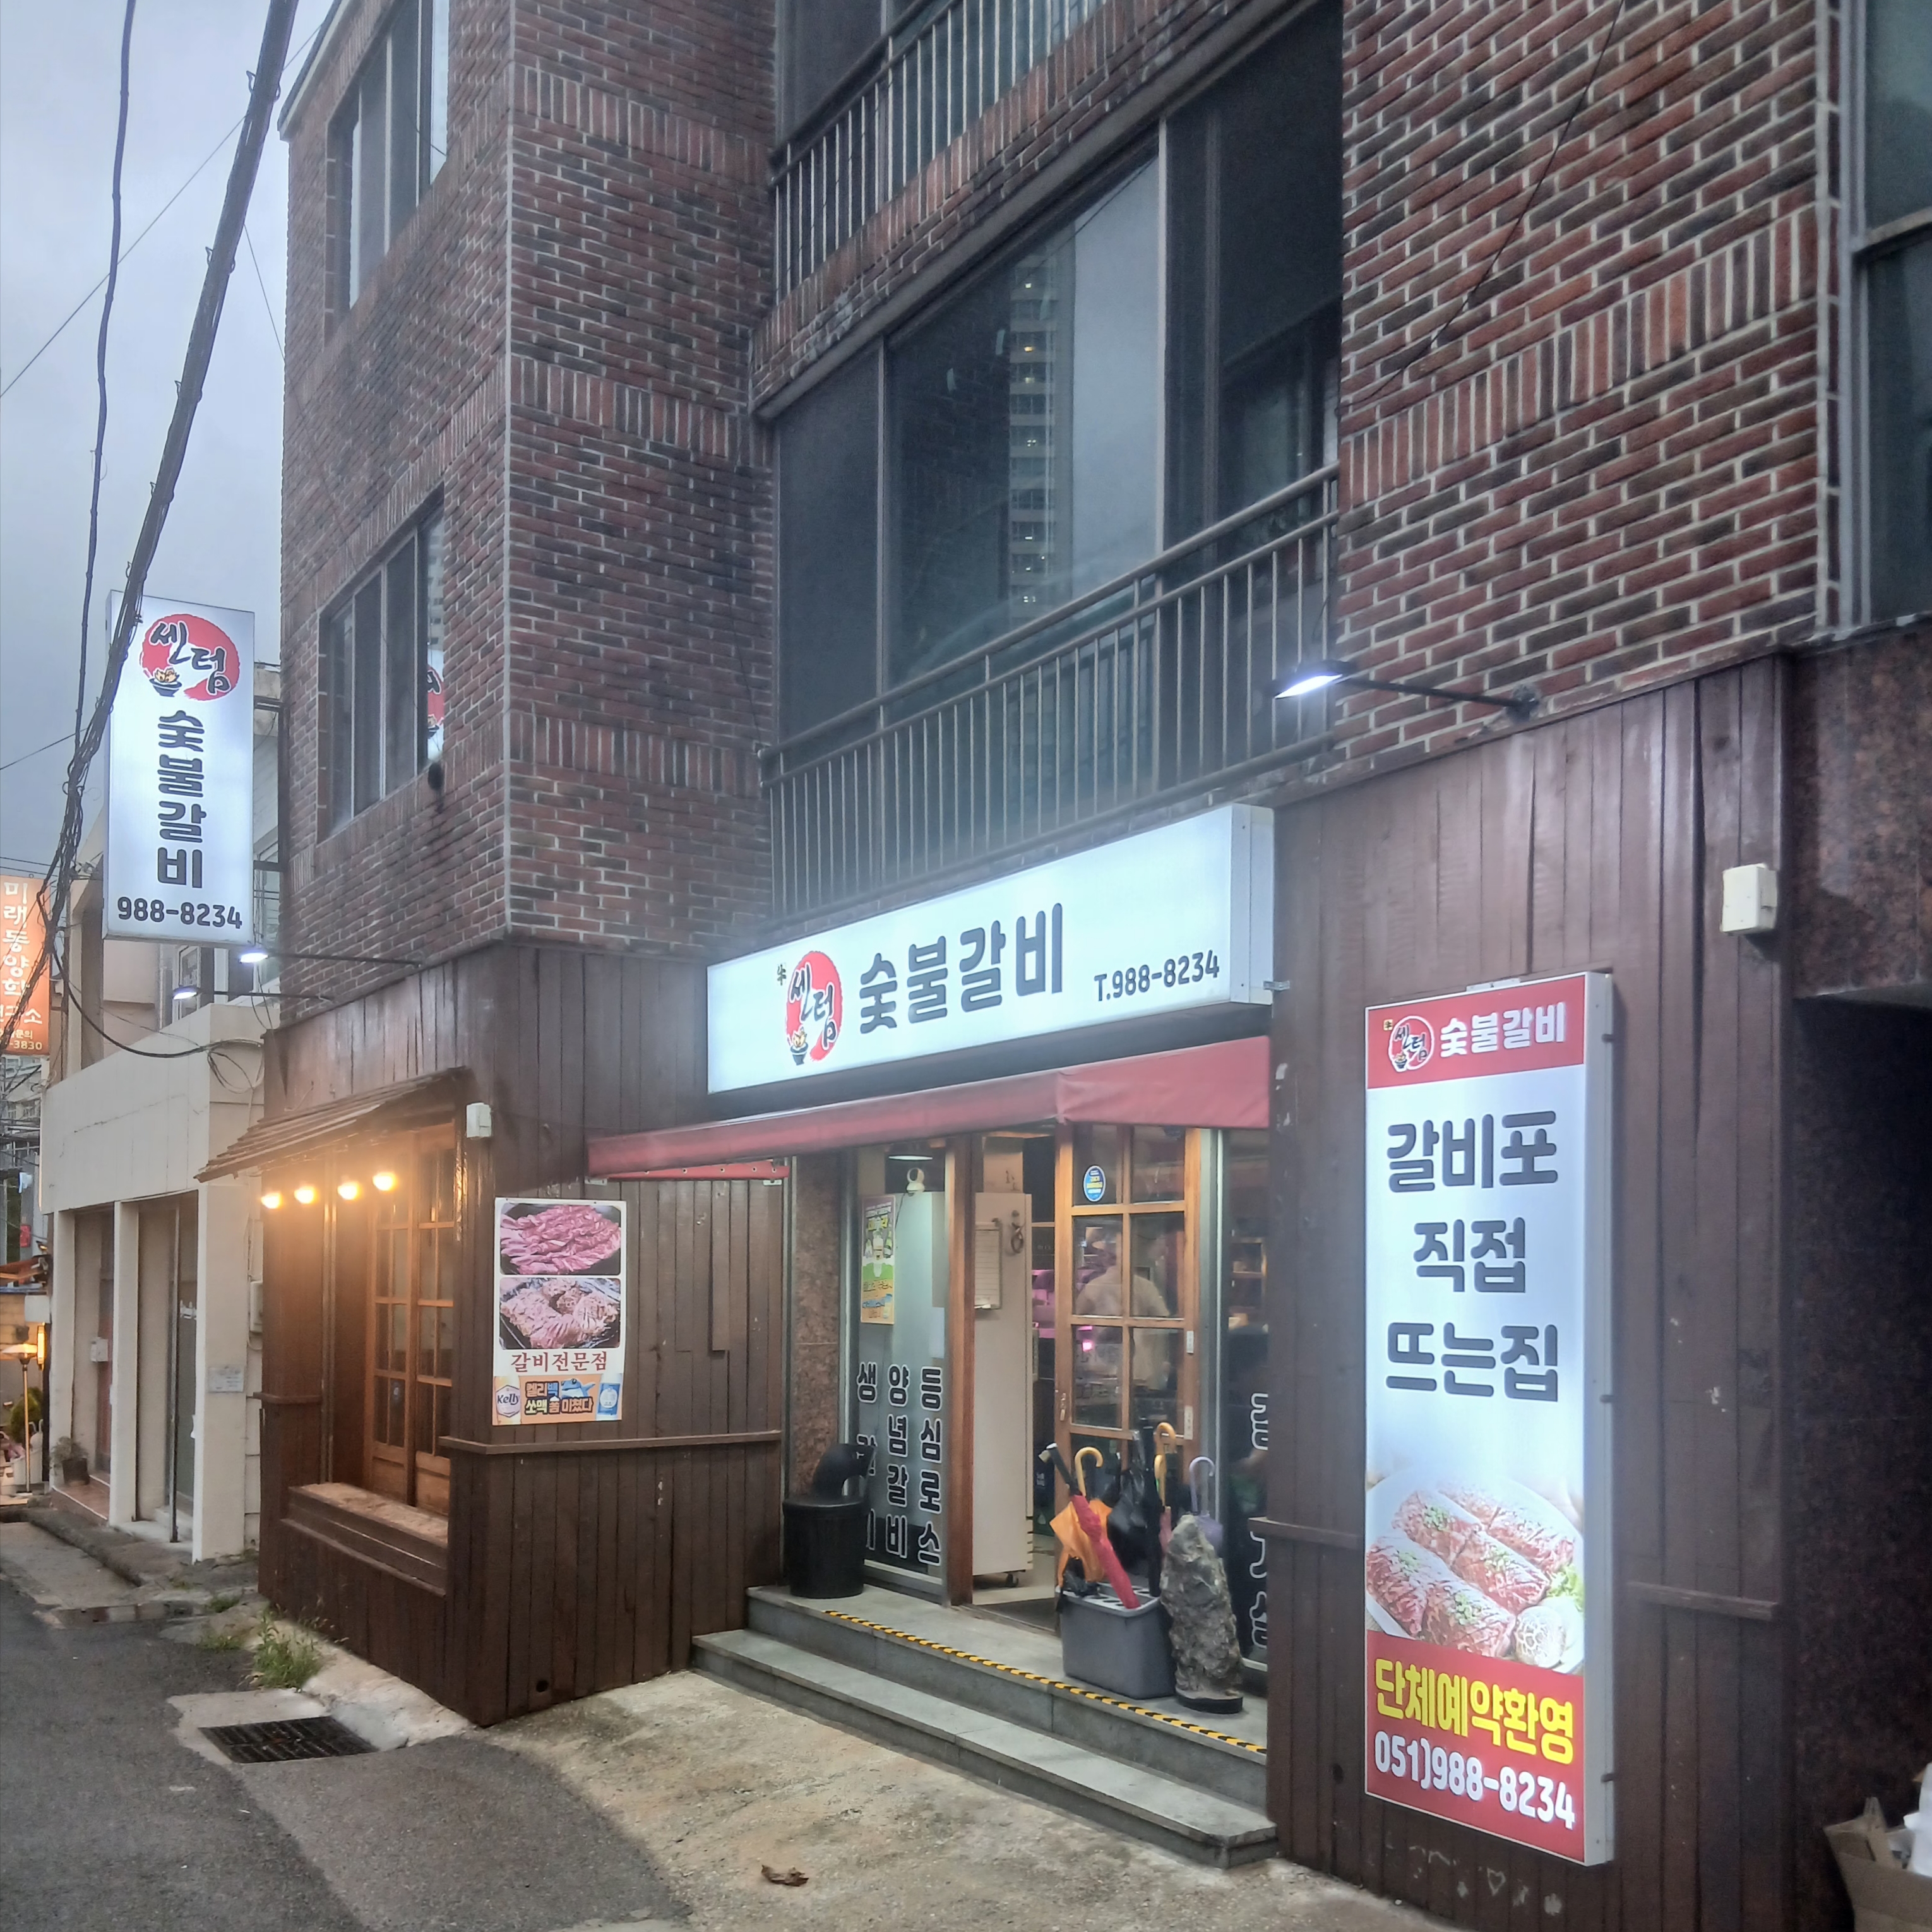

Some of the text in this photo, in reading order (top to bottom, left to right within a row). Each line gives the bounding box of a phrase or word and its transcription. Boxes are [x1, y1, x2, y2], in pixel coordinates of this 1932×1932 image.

[157, 710, 207, 889] 숯불갈비
[117, 897, 242, 929] 988-8234
[859, 903, 1063, 1034] 숯불갈비
[1094, 950, 1220, 1002] T.988-8234
[1440, 1001, 1566, 1058] 숯불갈비
[1386, 1111, 1558, 1193] 갈비포
[1414, 1217, 1526, 1293] 직접
[497, 1393, 520, 1405] Kelly
[511, 1351, 607, 1373] 갈비전문점
[1386, 1322, 1558, 1402] 뜨는집
[886, 1364, 910, 1558] 양념갈비
[917, 1366, 942, 1566] 등심로스
[1374, 1659, 1574, 1765] 단체예약환영
[1374, 1731, 1575, 1830] 051)988-8234
